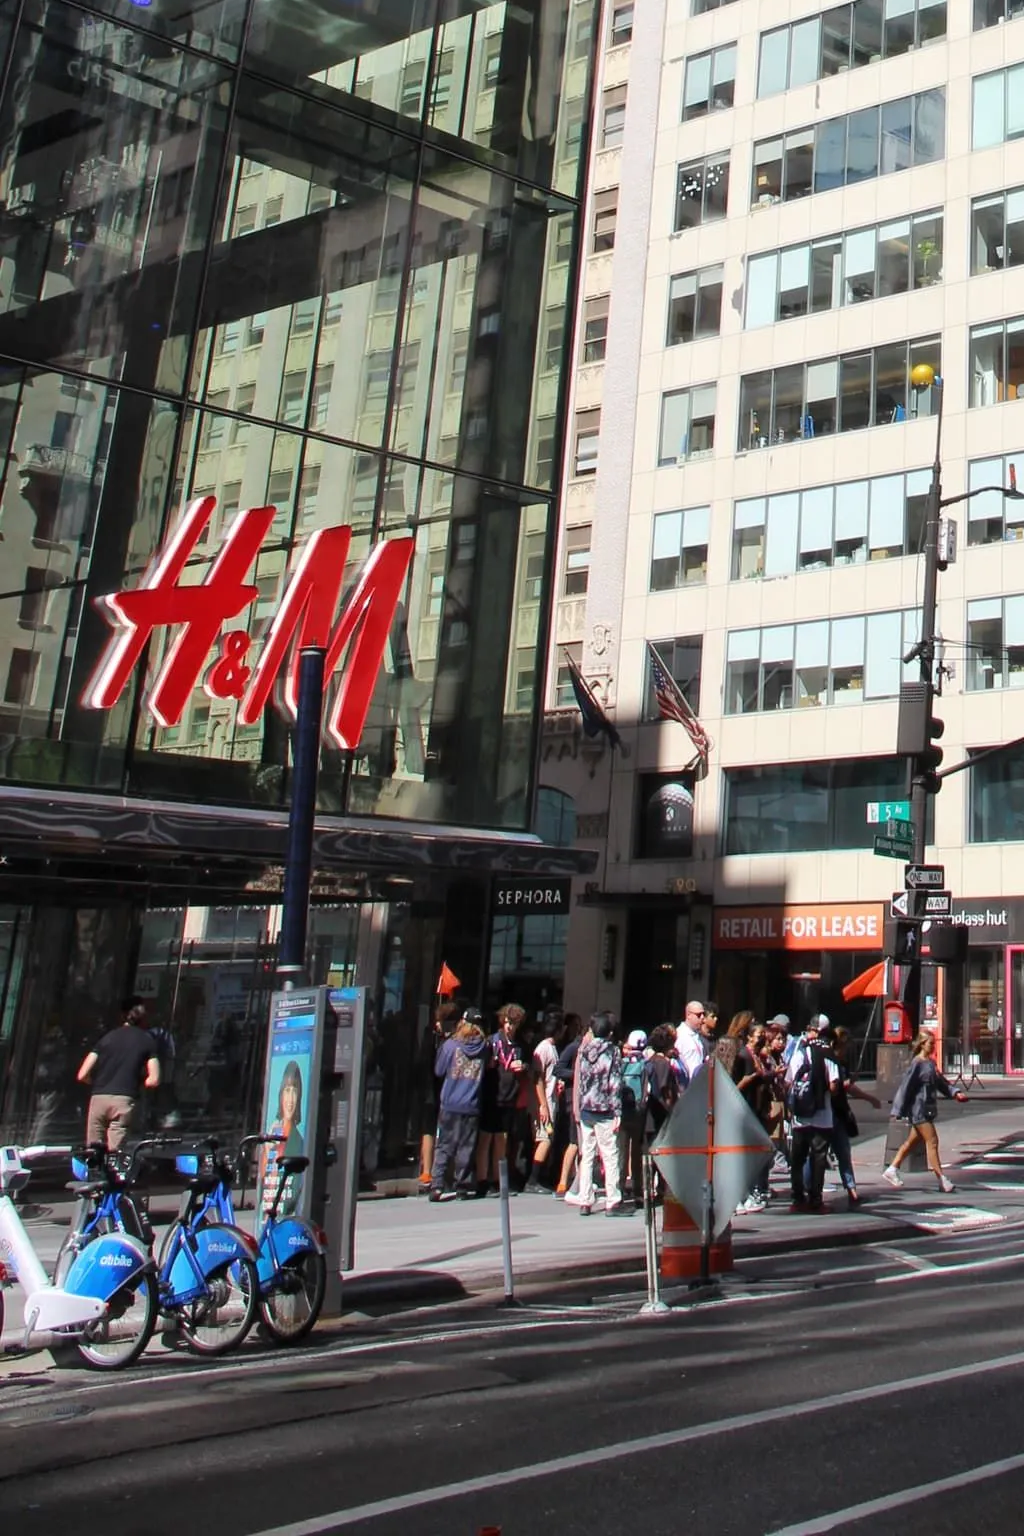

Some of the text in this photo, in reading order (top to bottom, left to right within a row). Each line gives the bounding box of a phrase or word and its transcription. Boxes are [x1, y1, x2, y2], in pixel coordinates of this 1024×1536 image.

[86, 494, 415, 750] H&M
[885, 804, 892, 820] 5
[909, 871, 943, 883] ONE WAY
[498, 888, 562, 905] SEPHORA
[927, 897, 946, 907] WAY
[986, 909, 1008, 926] hut
[719, 915, 877, 939] RETAIL FOR LEASE
